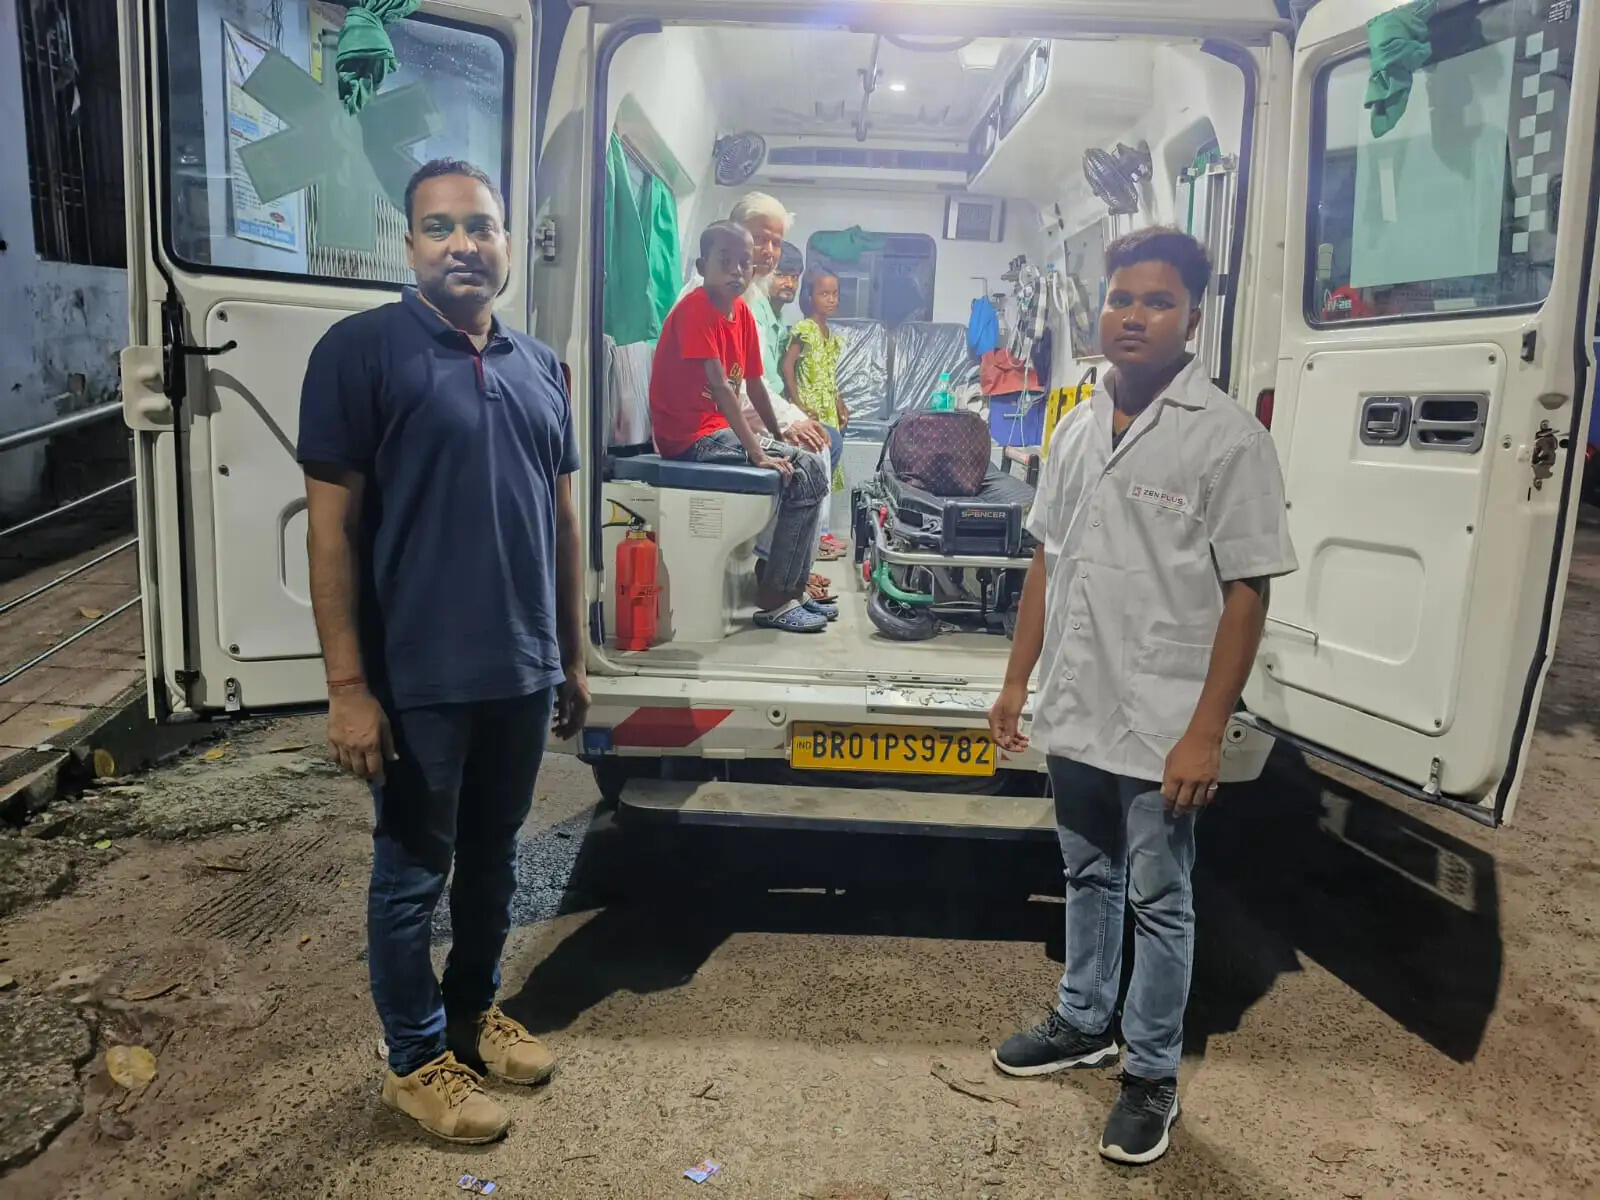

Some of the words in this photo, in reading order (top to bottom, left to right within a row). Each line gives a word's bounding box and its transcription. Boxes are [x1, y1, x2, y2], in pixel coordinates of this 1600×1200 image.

[1143, 489, 1160, 498] ZEN
[1160, 493, 1184, 505] PLUS
[961, 510, 1006, 519] SPENCER
